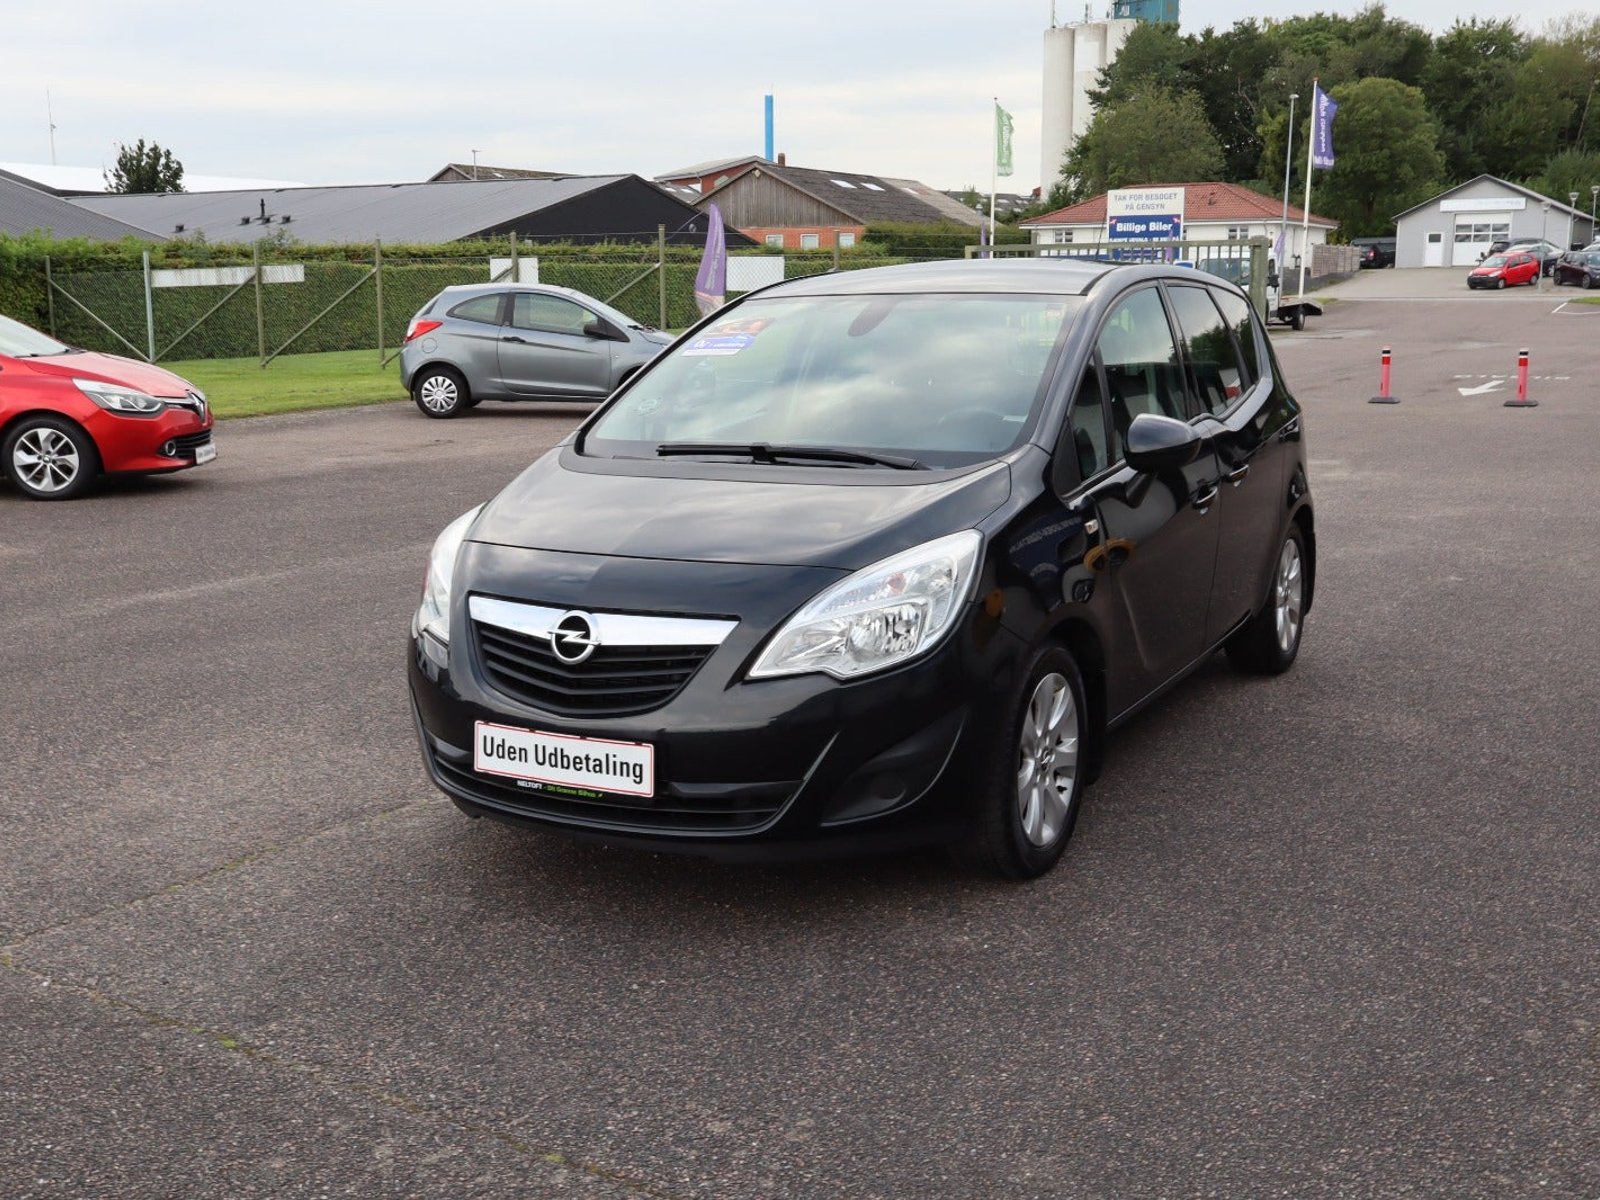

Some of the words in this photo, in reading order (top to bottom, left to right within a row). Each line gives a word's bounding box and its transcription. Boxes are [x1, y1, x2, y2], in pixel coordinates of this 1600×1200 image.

[1129, 193, 1143, 201] FOR
[1136, 202, 1165, 210] GENSYN
[1116, 222, 1146, 233] Billige
[1149, 221, 1173, 231] Biler
[482, 735, 528, 764] Uden
[534, 743, 644, 785] Udbetaling
